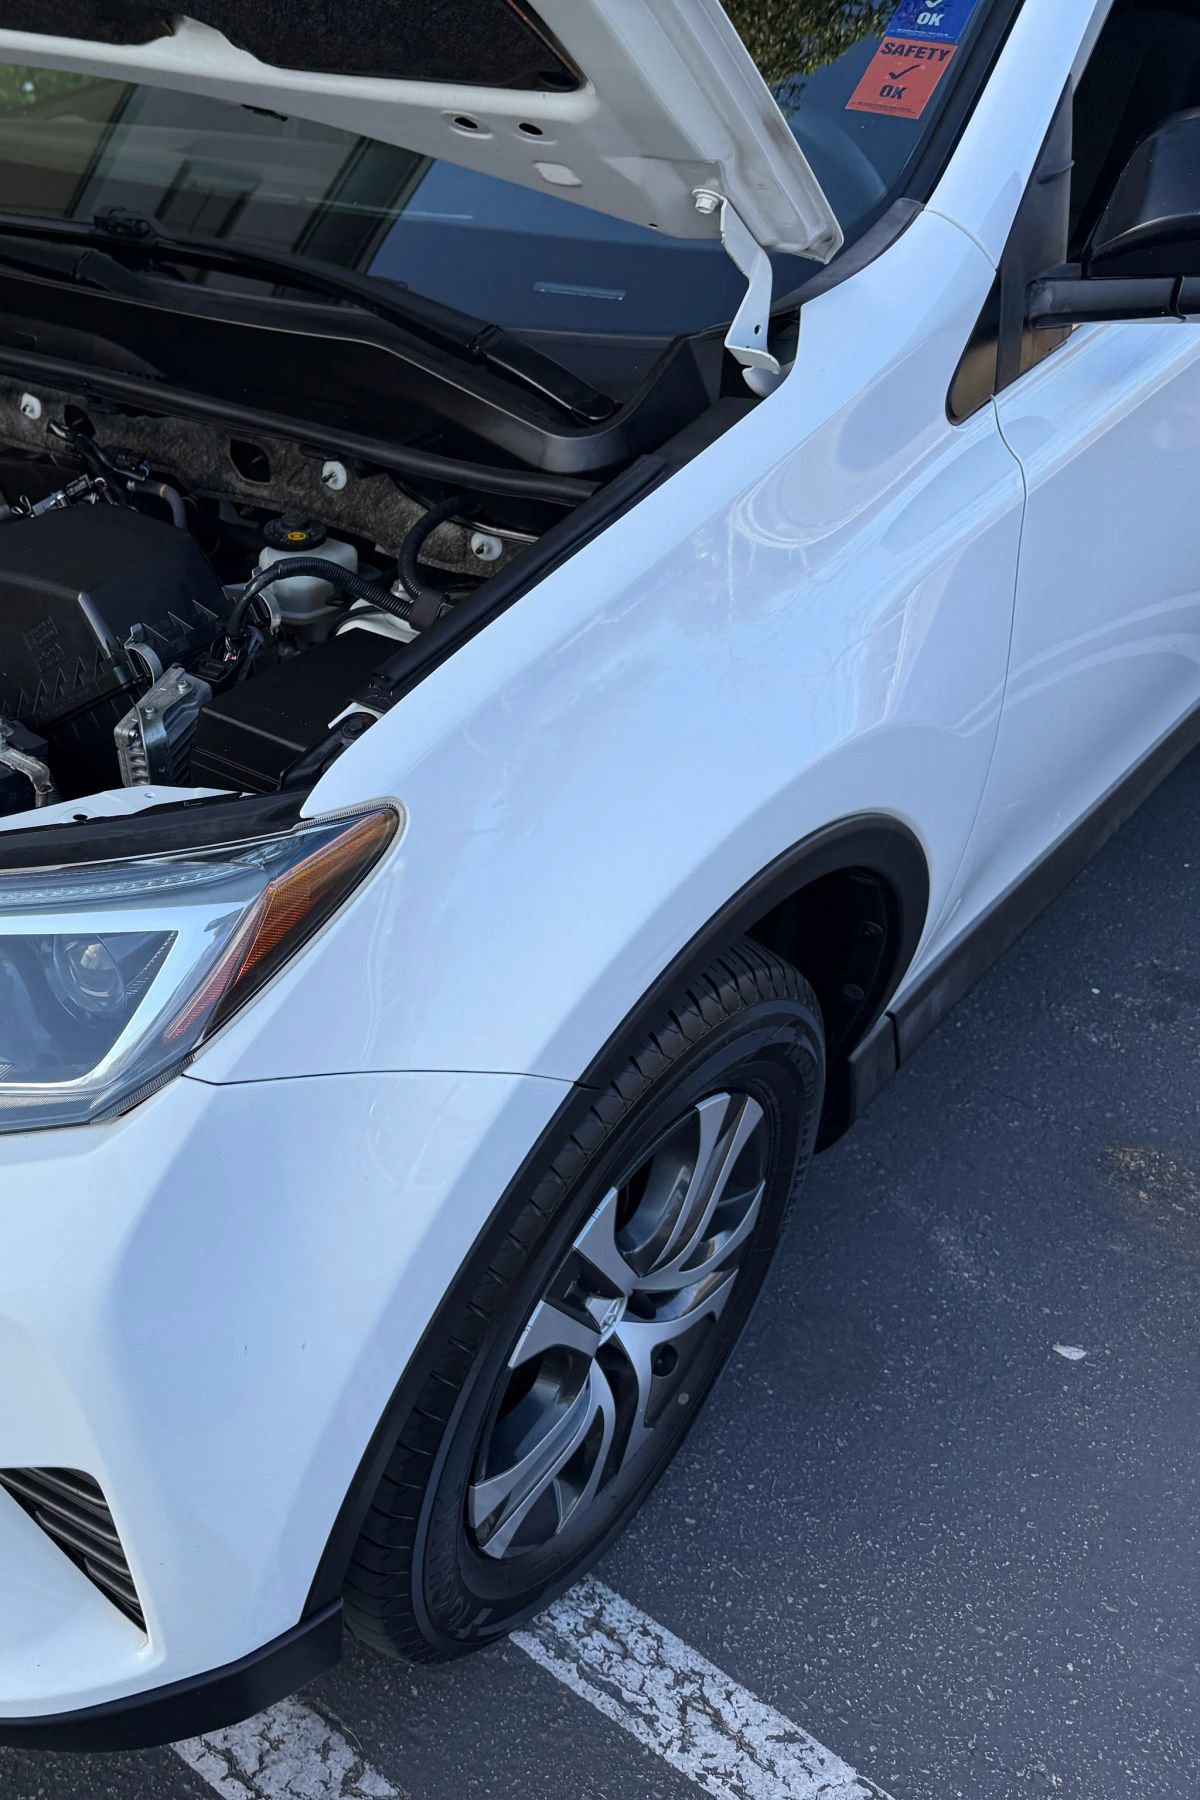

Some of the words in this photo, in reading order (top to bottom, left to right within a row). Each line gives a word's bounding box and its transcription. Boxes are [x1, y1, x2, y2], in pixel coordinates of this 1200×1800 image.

[917, 12, 944, 26] OK
[880, 42, 950, 61] SAFETY
[880, 85, 907, 99] OK
